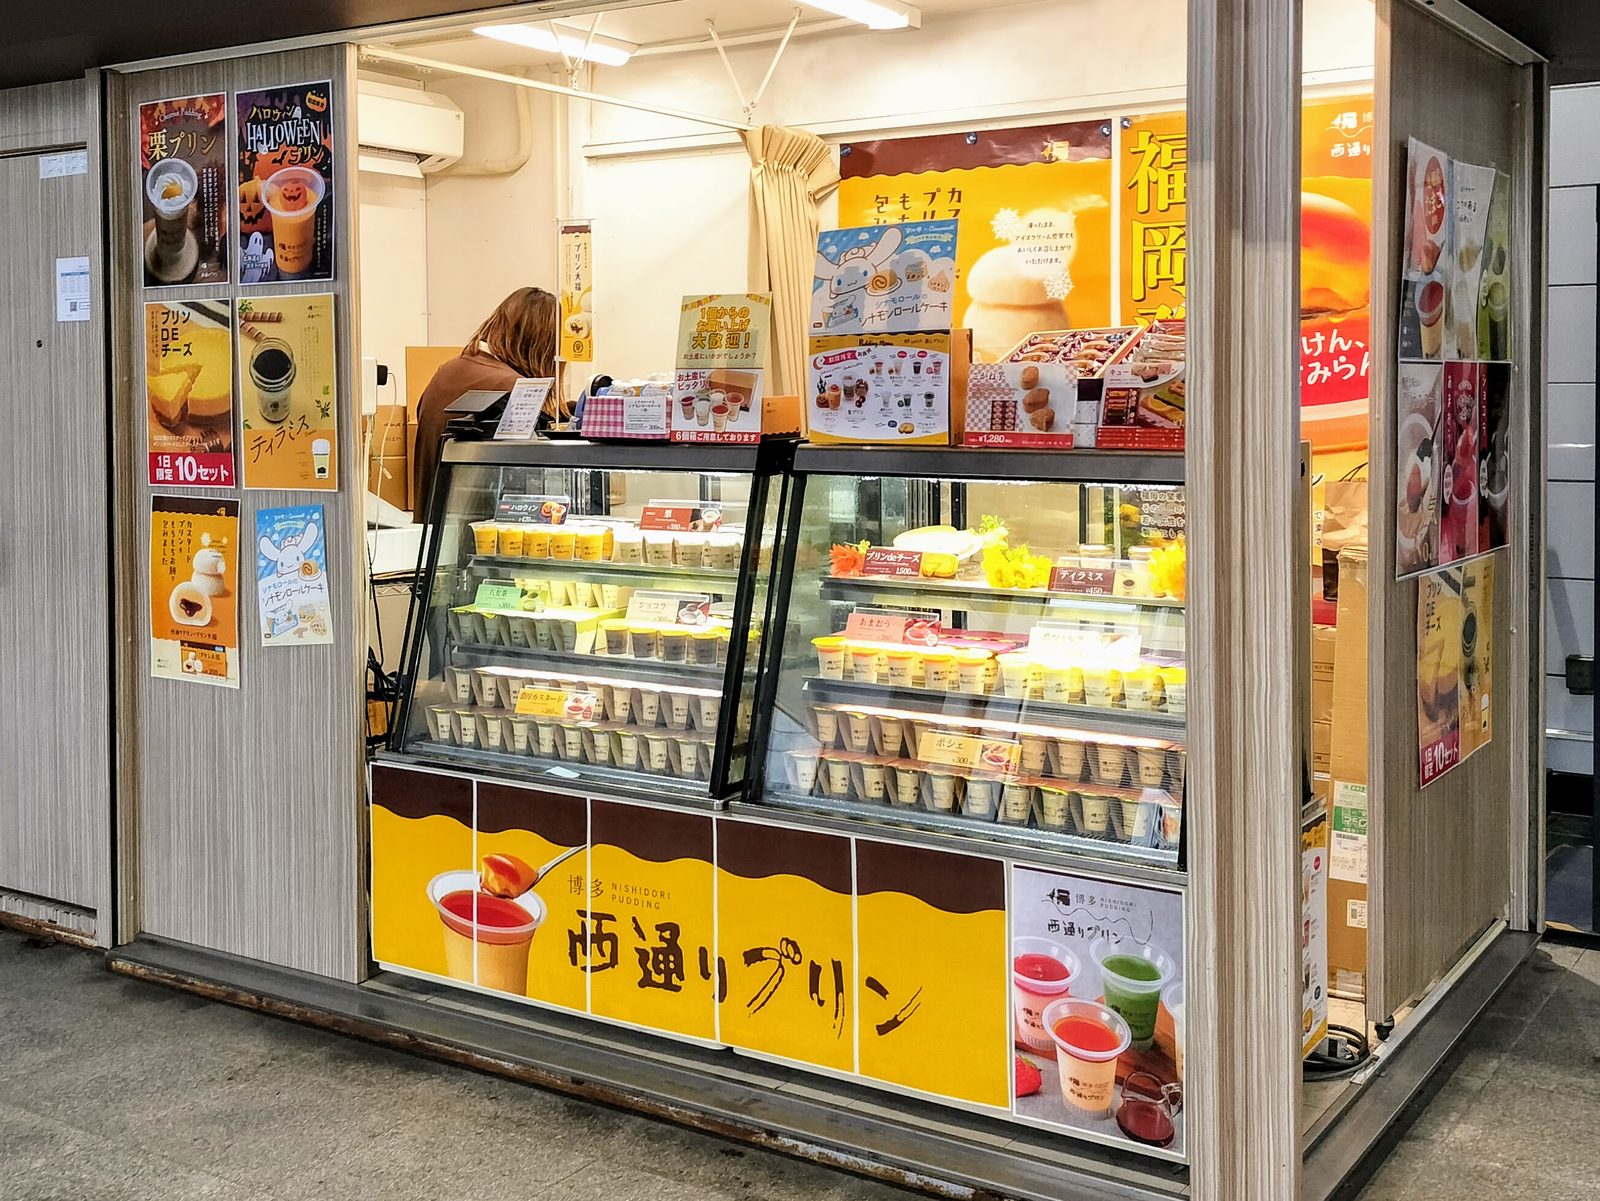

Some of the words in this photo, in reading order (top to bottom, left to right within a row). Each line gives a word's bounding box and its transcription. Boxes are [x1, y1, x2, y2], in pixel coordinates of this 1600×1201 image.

[248, 104, 296, 121] ハロウィン
[246, 118, 321, 152] HALLOWEEN
[148, 127, 217, 161] 栗プリン
[288, 143, 325, 165] プリン
[160, 310, 191, 326] プリン
[860, 301, 949, 328] シナモンロールケーキ
[160, 327, 179, 341] DE
[160, 341, 193, 358] チーズ
[676, 371, 706, 382] お土産に
[248, 413, 311, 464] ティラミス
[675, 431, 757, 442] 6個箱ご用意しております
[978, 434, 1005, 445] ¥1,280
[157, 455, 171, 468] 1日
[175, 455, 230, 482] 10セット
[156, 468, 174, 481] 限定
[510, 502, 539, 513] ハロウィン
[866, 550, 921, 563] プリンdeチーズ
[1059, 569, 1104, 582] ティラミス
[859, 617, 891, 629] あまおう
[567, 874, 605, 899] 博多
[611, 882, 671, 900] NISHIDORI
[611, 894, 661, 910] PUDDING
[1075, 892, 1097, 906] 博多
[1047, 918, 1124, 945] 西通りプリン
[567, 908, 923, 1040] 西通りプリン
